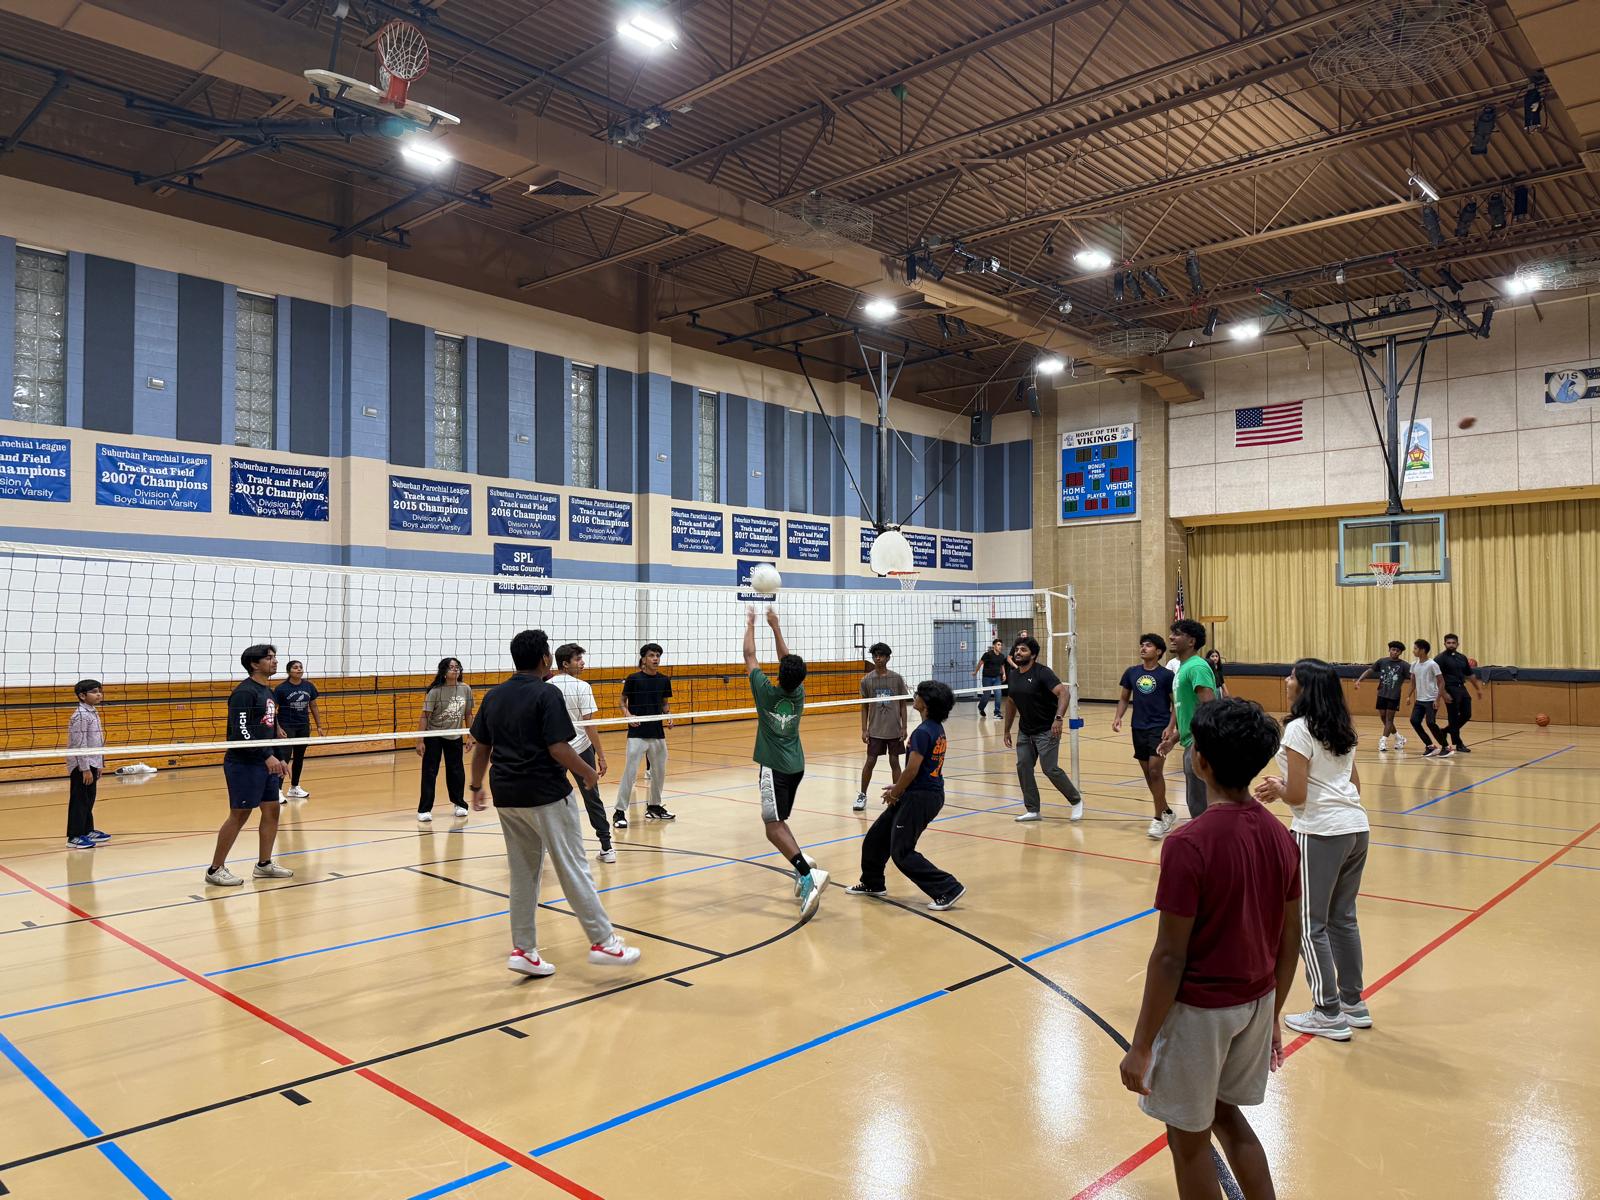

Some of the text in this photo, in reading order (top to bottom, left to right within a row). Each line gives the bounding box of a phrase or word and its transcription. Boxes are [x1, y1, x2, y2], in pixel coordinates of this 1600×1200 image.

[1558, 372, 1578, 381] VIS
[1077, 434, 1117, 445] VIKINGS
[36, 442, 67, 452] League
[22, 454, 51, 464] Field
[101, 448, 208, 466] Suburban Parochial League
[117, 462, 195, 477] Track and Field
[234, 461, 326, 478] Suburban Parochial League
[24, 479, 32, 487] A
[102, 471, 208, 491] 2007 Champions
[247, 474, 314, 488] Track and Field
[1106, 482, 1133, 490] VISITOR
[21, 488, 54, 498] Varsity
[235, 483, 325, 502] 2012 Champions
[392, 480, 470, 495] Suburban Parochial League
[1063, 487, 1085, 495] HOME
[135, 489, 178, 499] Division A
[403, 492, 425, 500] Track
[442, 495, 459, 504] Field
[489, 489, 557, 503] Suburban Parochial League
[114, 495, 198, 510] Boys Junior Varsity
[258, 499, 302, 509] Division AA
[393, 500, 468, 515] 2015 Champions
[500, 500, 519, 508] Track
[533, 503, 548, 511] Field
[571, 498, 592, 506] Suburban
[257, 507, 304, 518] Boys Varsity
[412, 514, 436, 522] Division
[491, 507, 556, 521] 2016 Champions
[402, 521, 418, 529] Boys
[441, 524, 461, 532] Varsity
[572, 515, 629, 528] 2016 Champions
[509, 527, 541, 536] Boys Varsity
[672, 526, 721, 537] 2017 Champions
[735, 531, 778, 542] 2017 Champions
[514, 552, 533, 563] SPL
[502, 564, 545, 574] Cross Country
[240, 712, 250, 740] COACH
